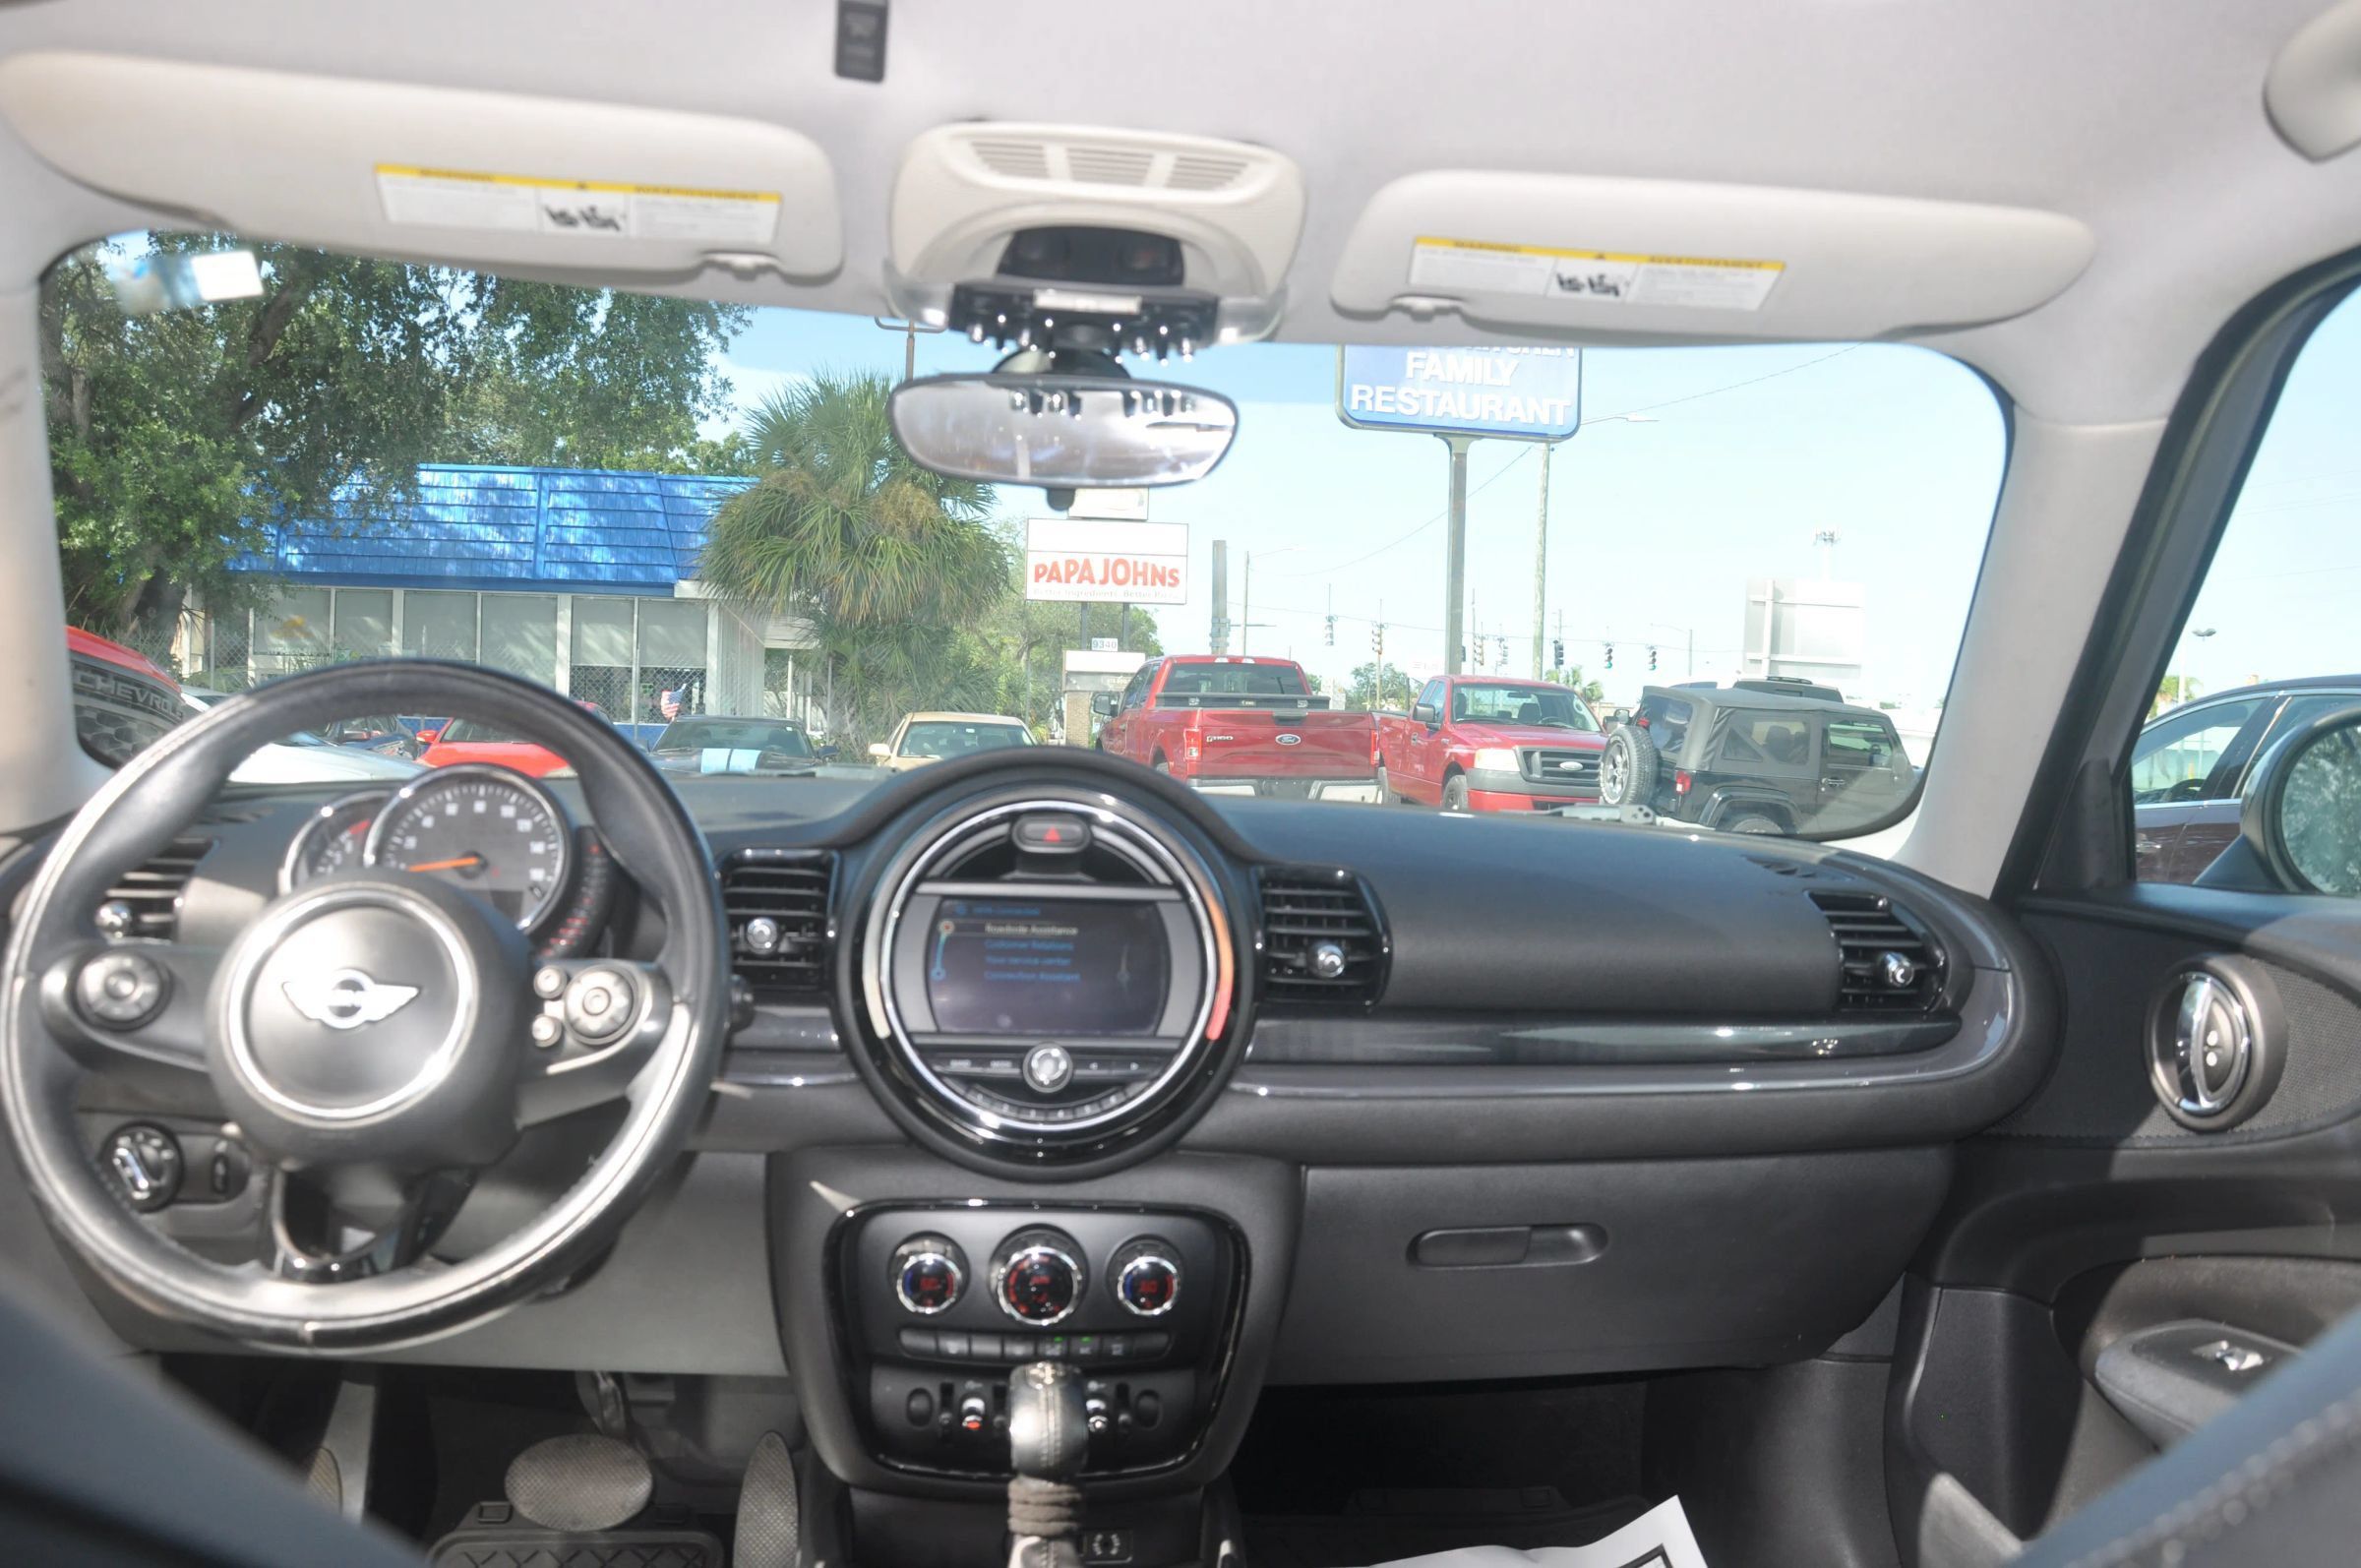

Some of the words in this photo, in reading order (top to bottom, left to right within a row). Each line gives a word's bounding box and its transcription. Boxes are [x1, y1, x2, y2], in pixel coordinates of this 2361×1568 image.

[1406, 351, 1520, 387] FAMILY
[1350, 384, 1573, 427] RESTAURANT
[1034, 557, 1096, 584] PAPA
[1099, 558, 1180, 588] JOHNS
